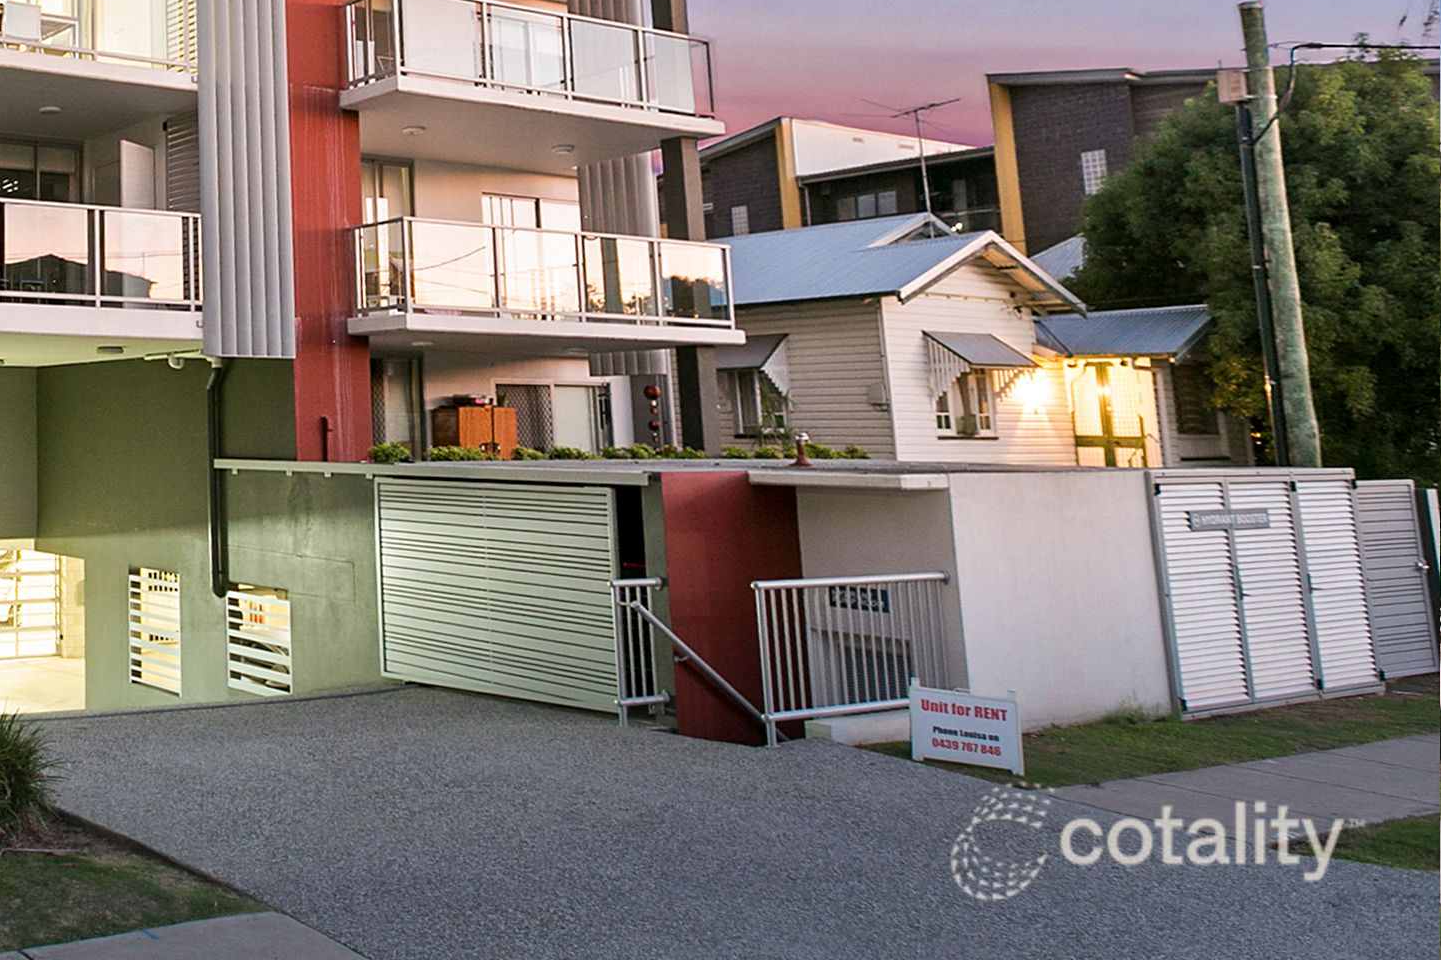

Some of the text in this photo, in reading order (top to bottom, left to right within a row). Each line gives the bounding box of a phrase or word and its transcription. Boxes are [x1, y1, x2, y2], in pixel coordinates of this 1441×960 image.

[1200, 513, 1267, 525] HYDRANT BOOSTER
[921, 699, 1008, 721] Unit for RENT
[932, 725, 1000, 742] Phone Louisa on
[932, 738, 959, 751] 0439
[961, 741, 979, 753] 767
